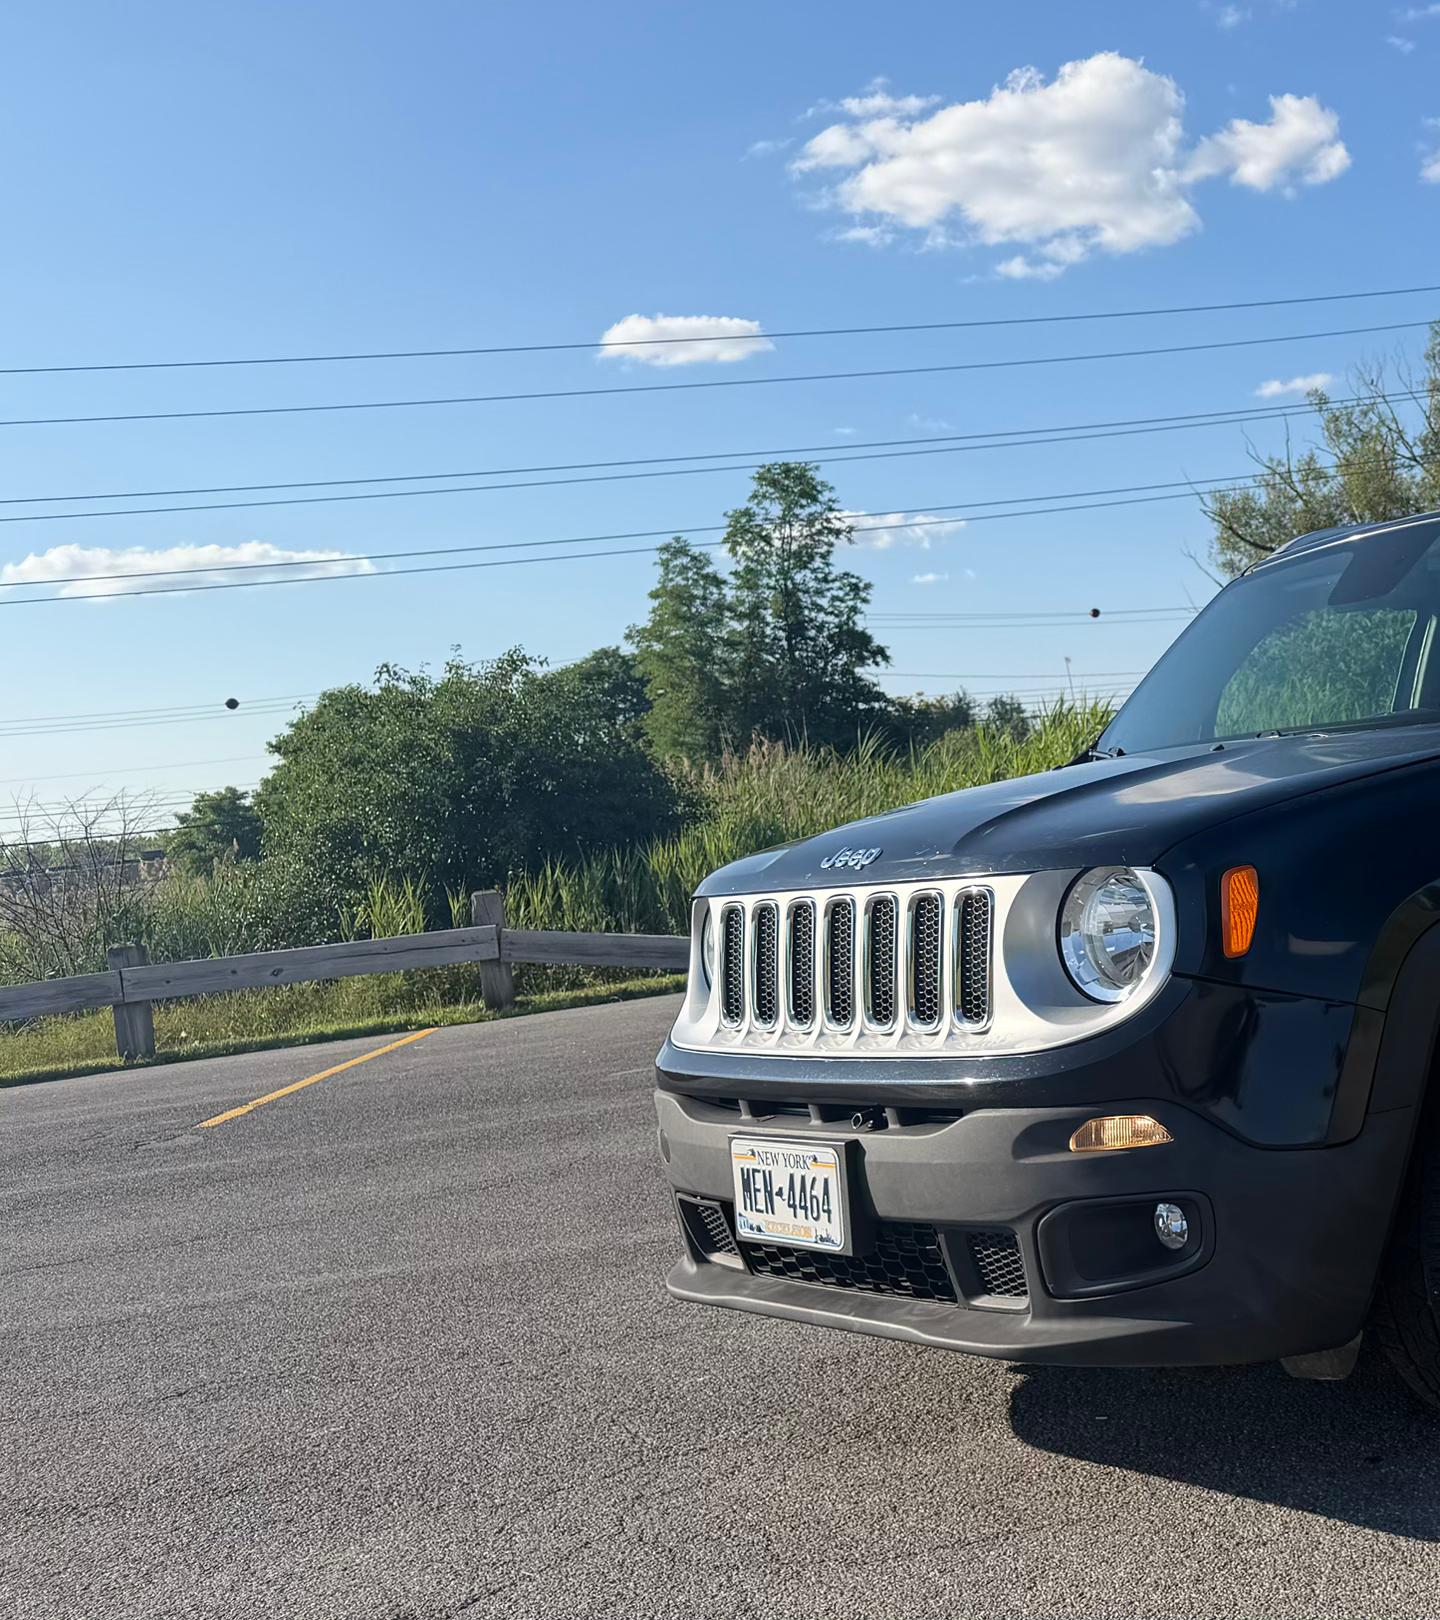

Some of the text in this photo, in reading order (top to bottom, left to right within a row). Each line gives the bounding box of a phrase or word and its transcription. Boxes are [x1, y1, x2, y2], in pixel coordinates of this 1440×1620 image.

[820, 846, 883, 871] Jeep
[757, 1150, 811, 1170] NEW YORK
